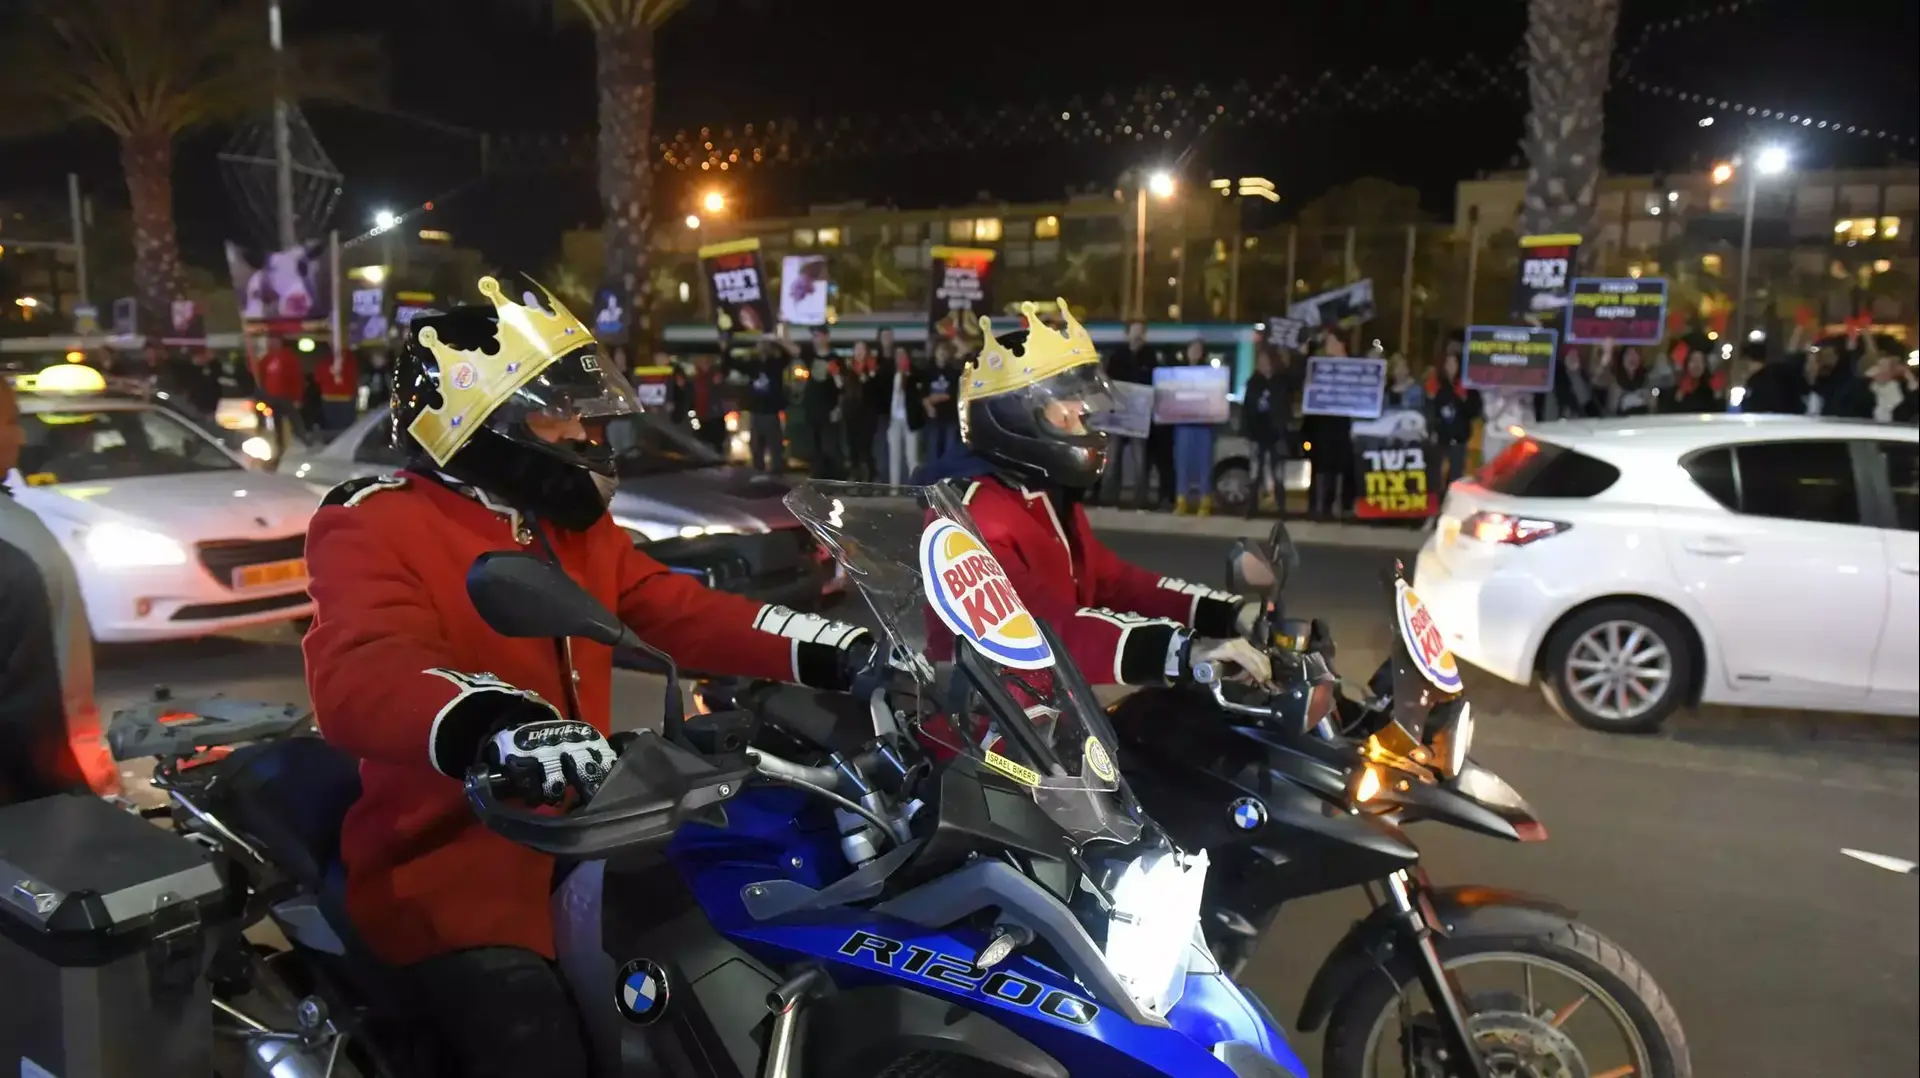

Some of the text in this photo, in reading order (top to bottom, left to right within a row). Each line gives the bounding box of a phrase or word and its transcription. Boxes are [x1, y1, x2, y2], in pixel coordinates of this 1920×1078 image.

[1362, 447, 1427, 472] בשר
[1365, 471, 1427, 496] רצח
[987, 752, 1037, 783] ISRAEL BIKERS
[837, 929, 1100, 1027] R1200
